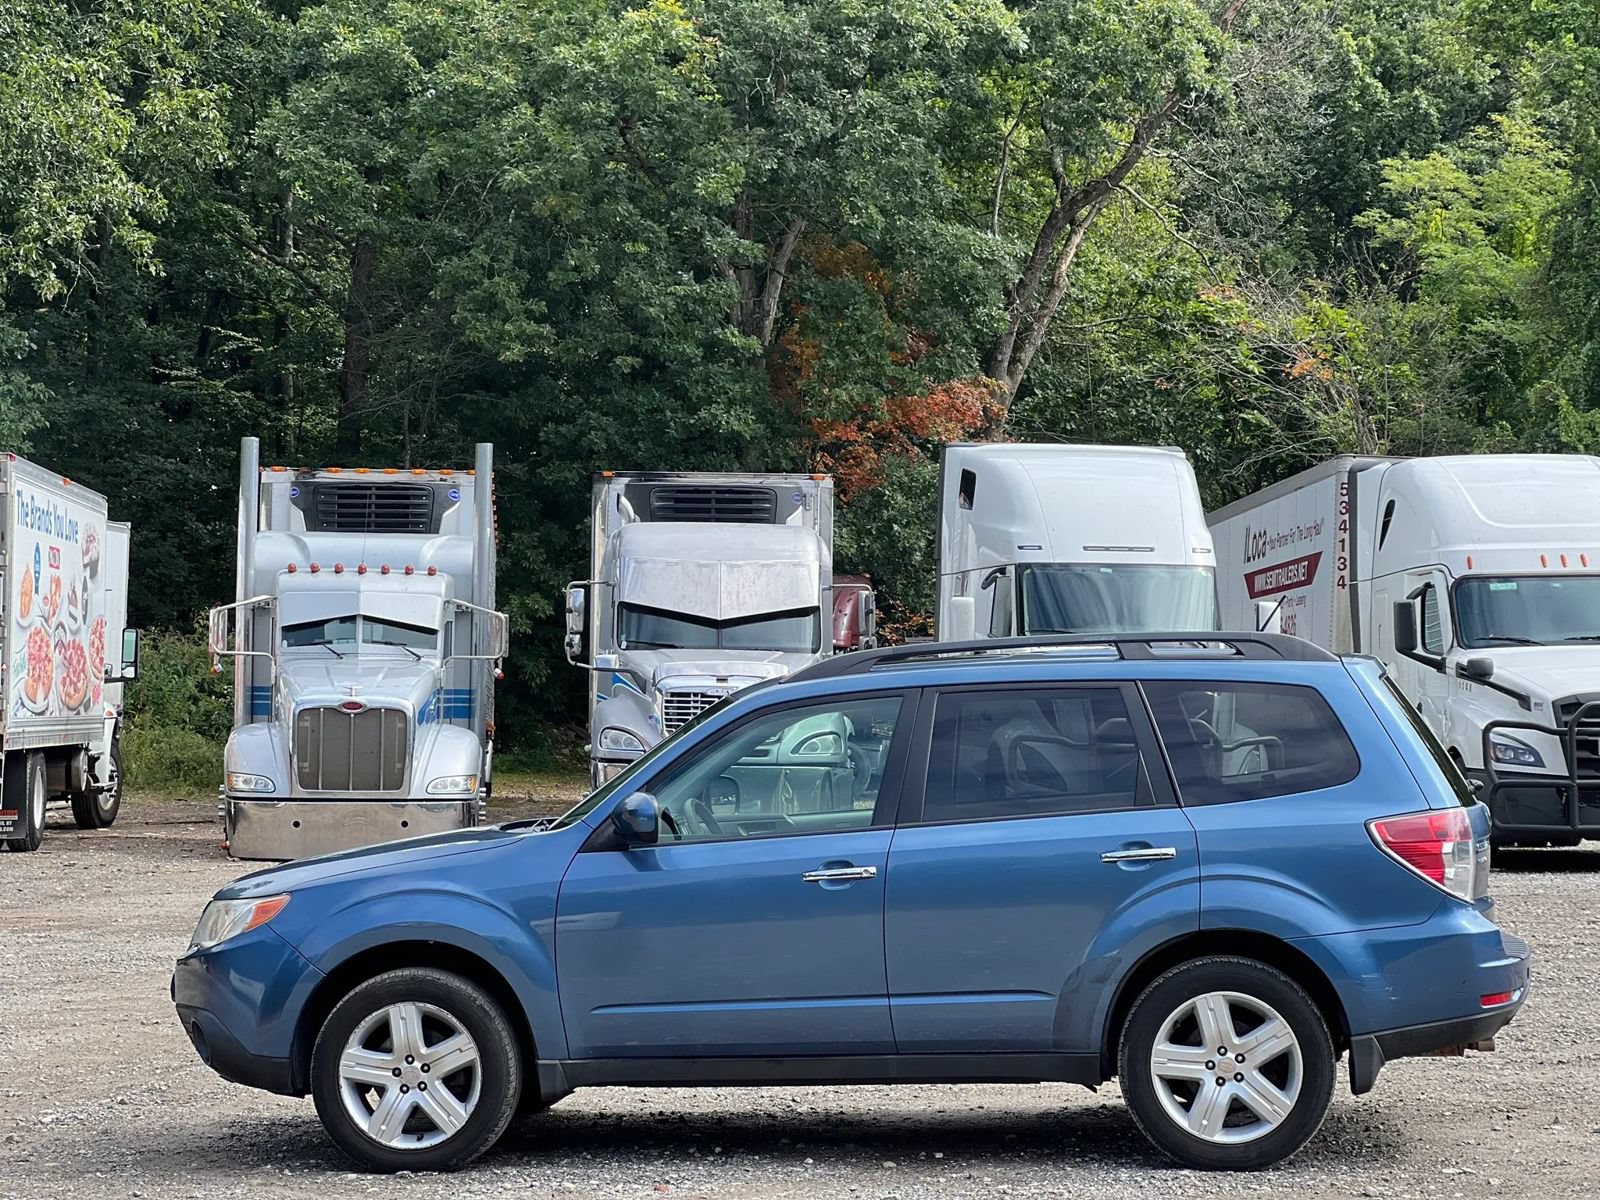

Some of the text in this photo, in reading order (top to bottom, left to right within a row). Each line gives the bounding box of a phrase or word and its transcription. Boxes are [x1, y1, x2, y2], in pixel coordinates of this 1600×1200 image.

[16, 489, 78, 544] The Brands You Love
[1337, 482, 1349, 589] 534134
